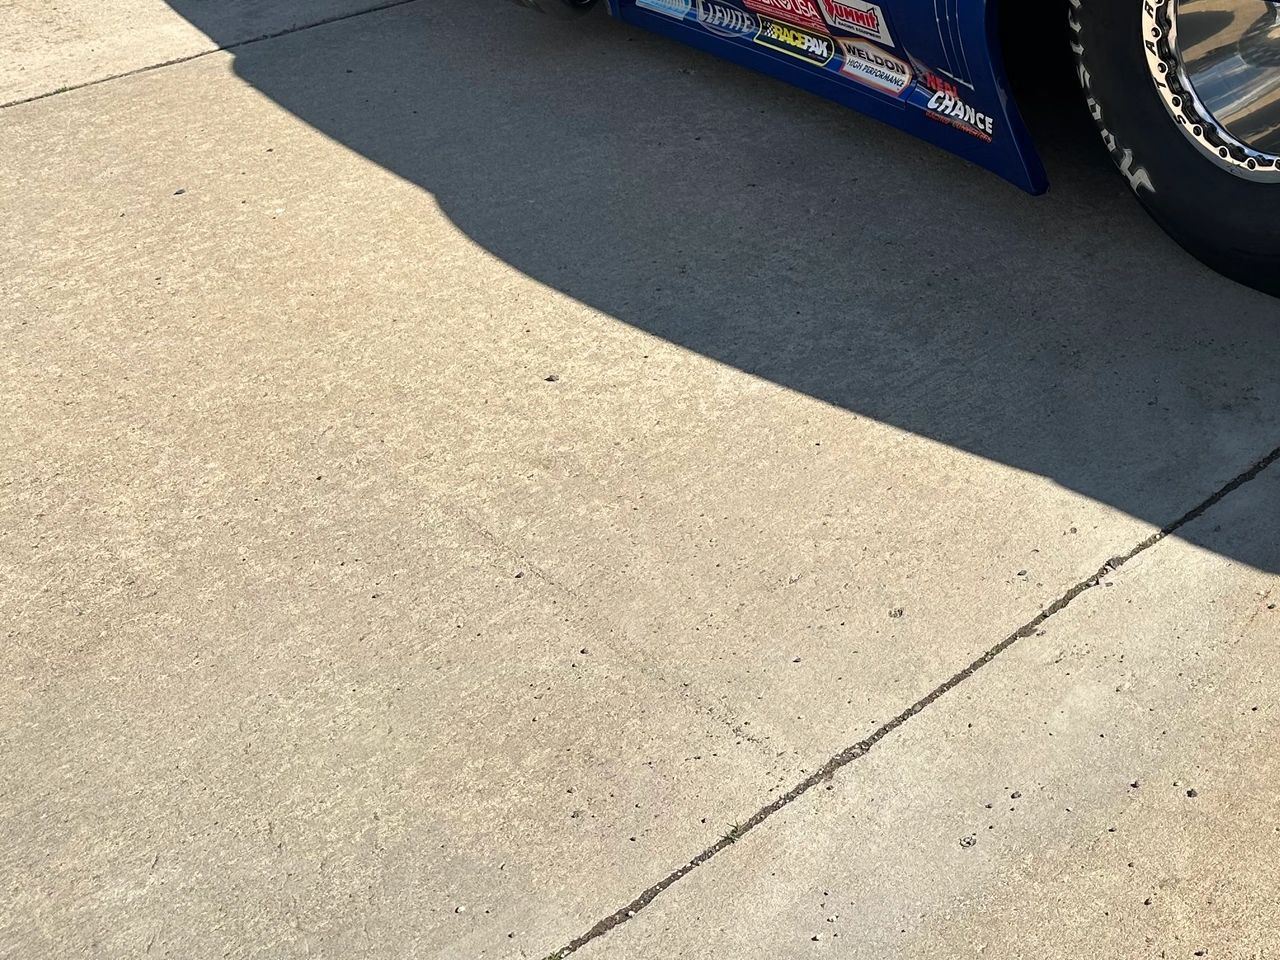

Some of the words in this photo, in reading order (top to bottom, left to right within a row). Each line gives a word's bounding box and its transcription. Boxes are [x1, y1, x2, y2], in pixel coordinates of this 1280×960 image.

[844, 43, 906, 75] WELDON
[847, 58, 861, 73] HIGH
[862, 64, 904, 88] PERFORMANCE
[927, 90, 993, 134] CHANCE
